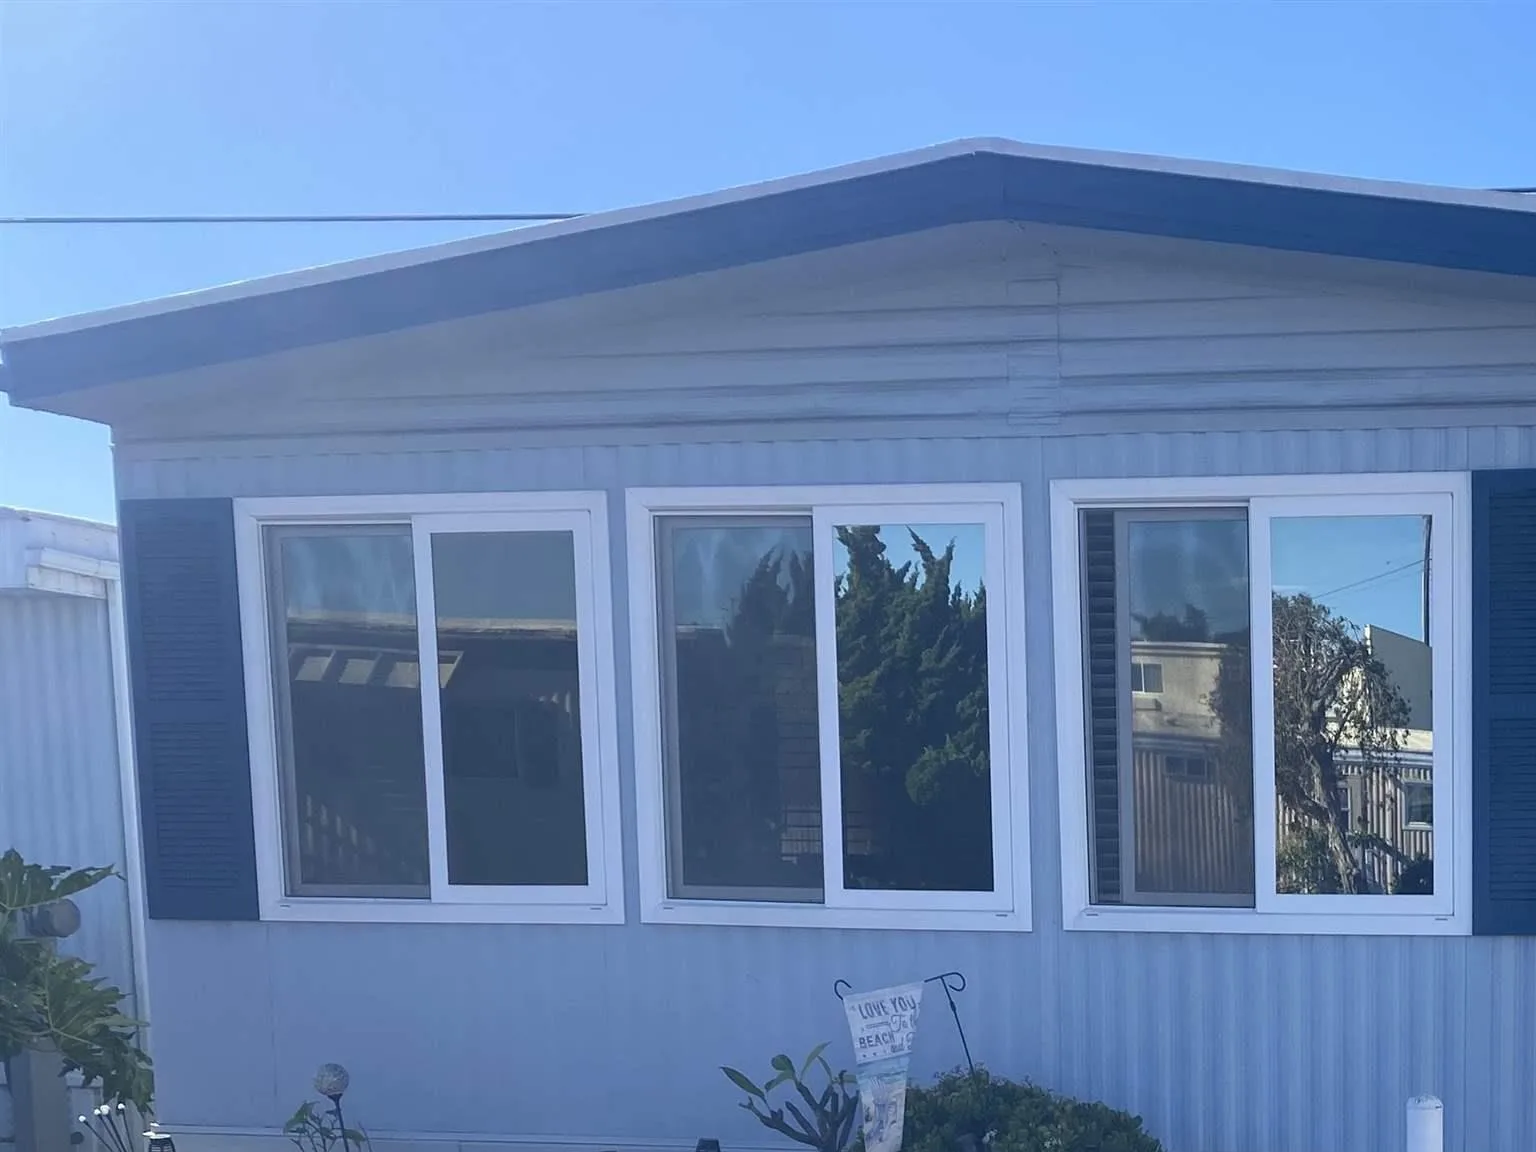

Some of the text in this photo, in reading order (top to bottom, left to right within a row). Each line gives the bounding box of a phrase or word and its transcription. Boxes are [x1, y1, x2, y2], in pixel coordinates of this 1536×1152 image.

[858, 995, 917, 1020] LOVE YOU
[858, 1031, 896, 1049] BEACH
